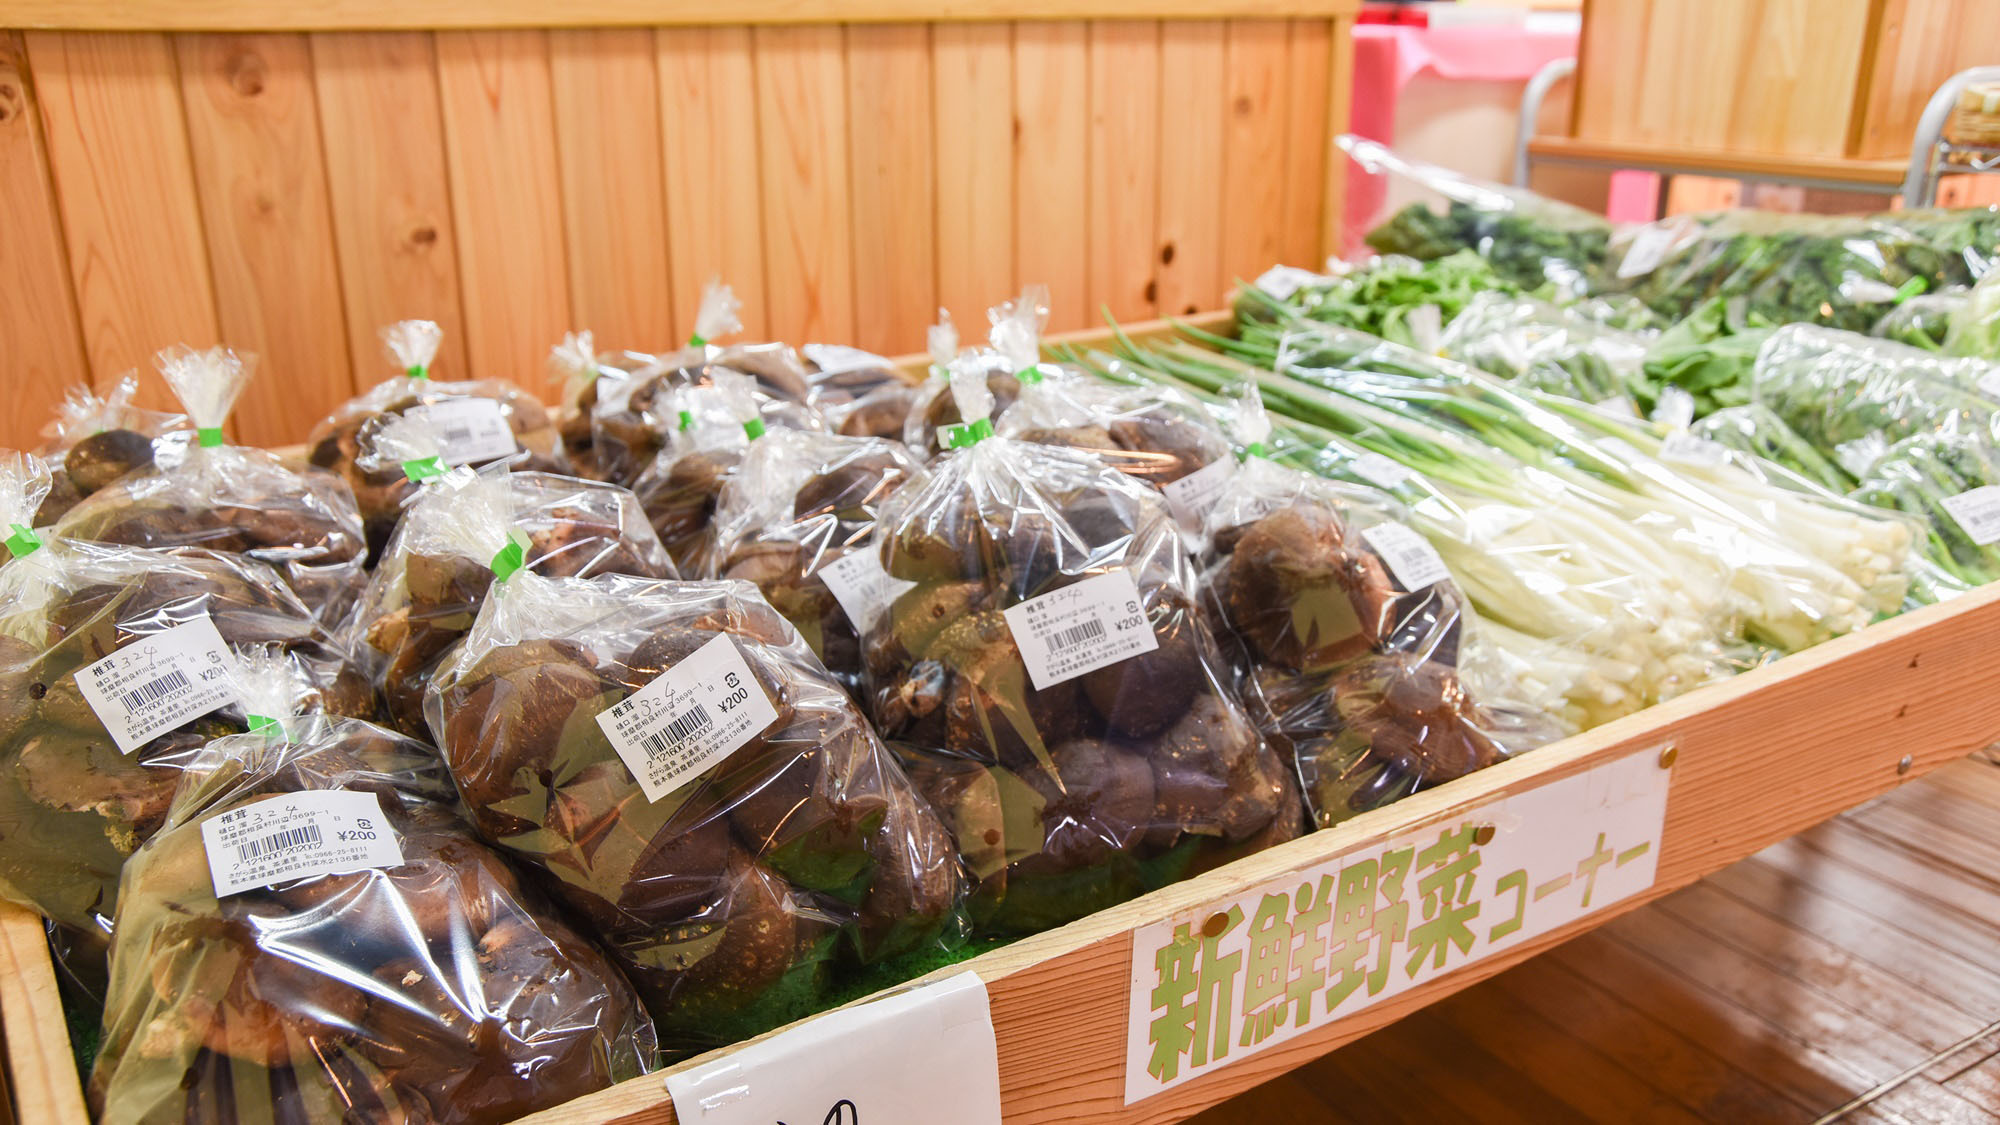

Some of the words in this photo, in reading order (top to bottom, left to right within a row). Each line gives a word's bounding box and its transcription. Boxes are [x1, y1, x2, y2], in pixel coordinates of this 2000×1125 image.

[1115, 614, 1143, 632] ¥200
[92, 659, 116, 677] 椎茸
[611, 700, 635, 719] 椎茸
[717, 687, 749, 715] ¥200
[220, 809, 248, 824] 椎茸
[252, 805, 298, 824] 324
[337, 830, 377, 842] ¥200
[1147, 821, 1651, 1084] 新鮮野菜コーナー
